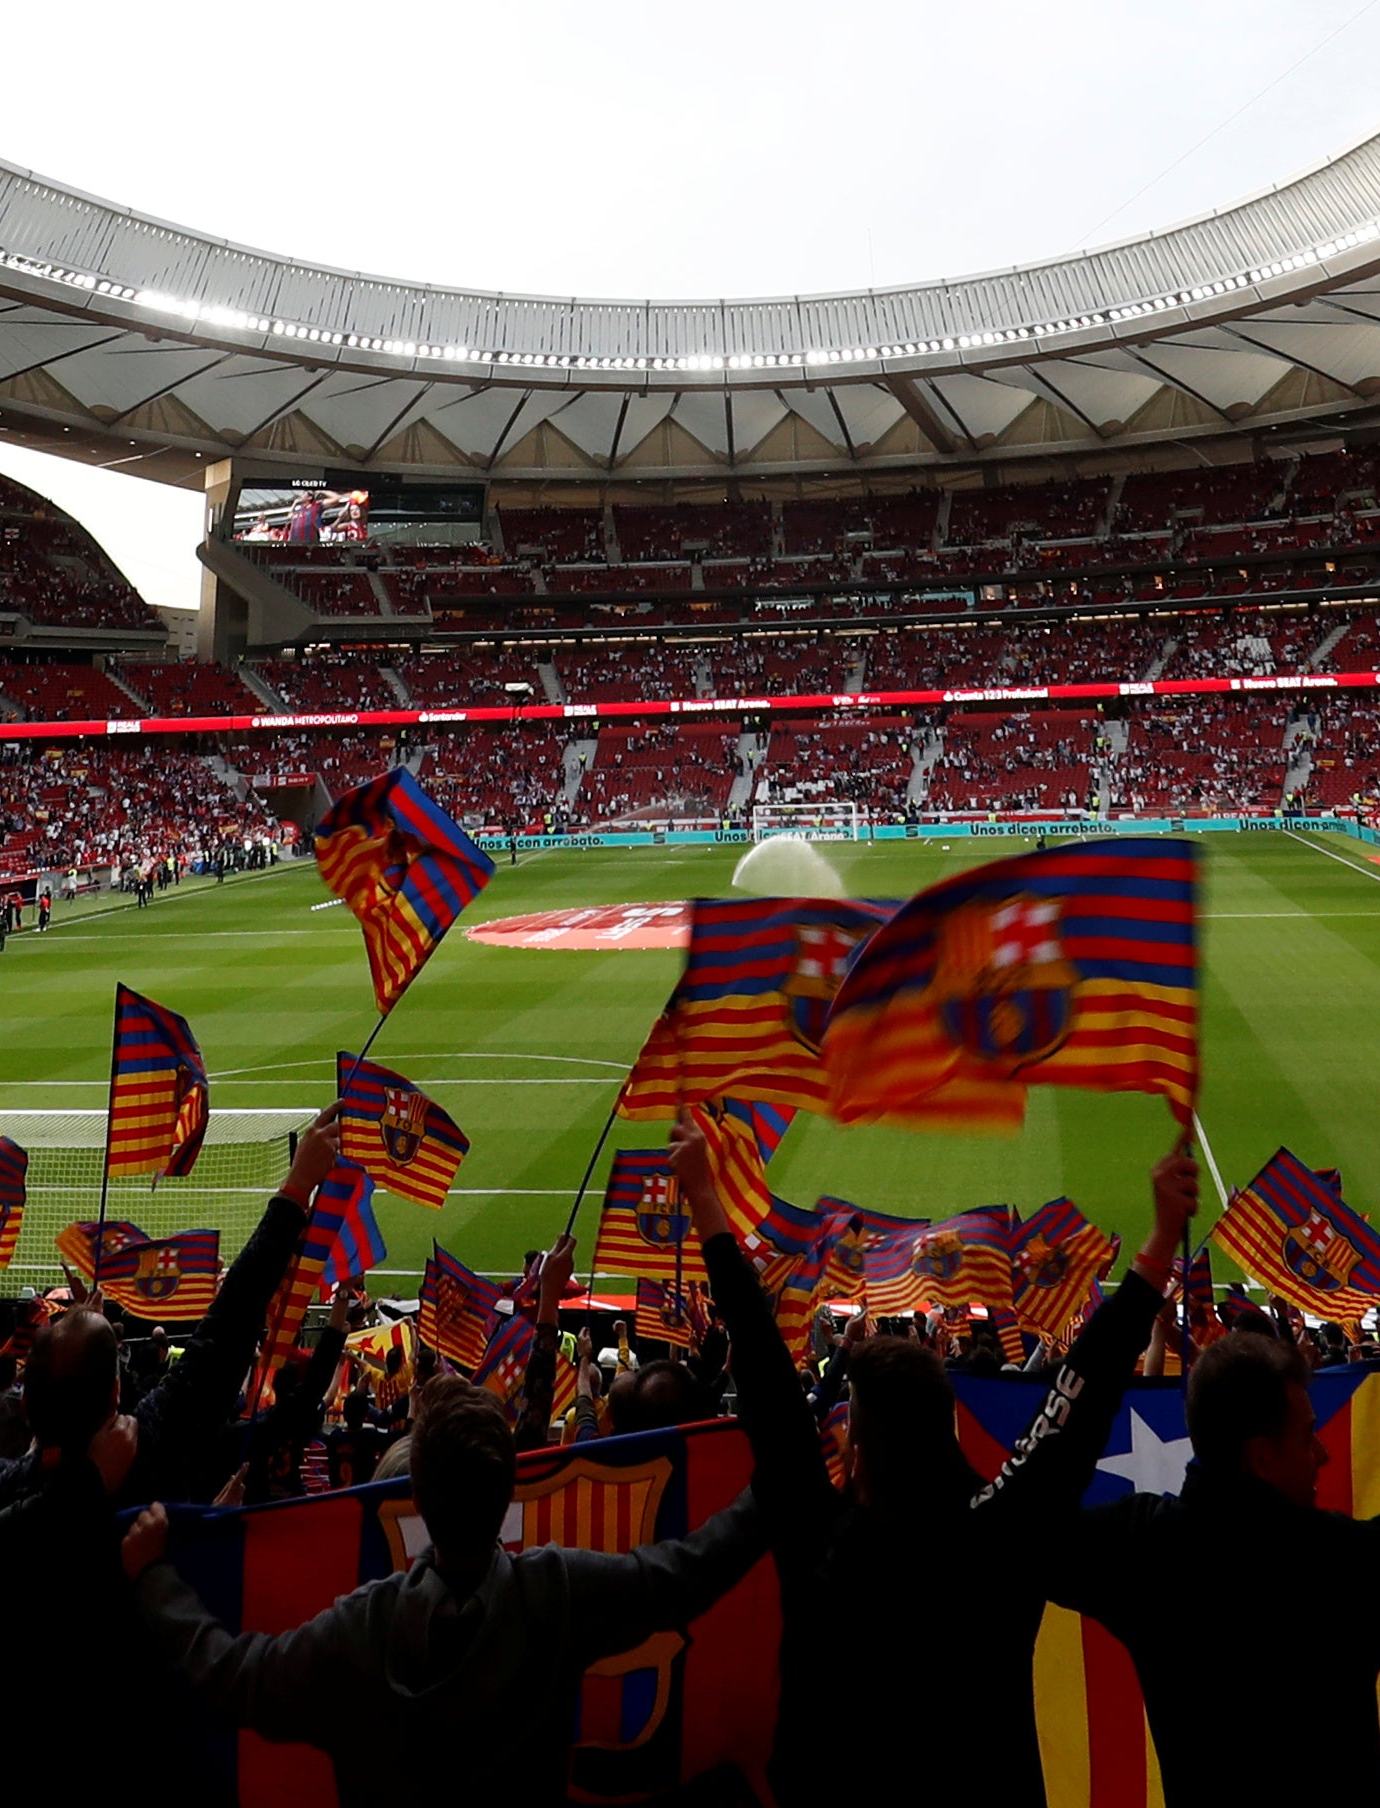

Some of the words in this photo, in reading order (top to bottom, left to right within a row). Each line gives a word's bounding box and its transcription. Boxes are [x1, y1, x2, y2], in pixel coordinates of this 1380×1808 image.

[1277, 677, 1301, 688] SEAT
[714, 699, 737, 710] SEAT
[261, 717, 294, 726] WANDA
[295, 714, 358, 725] METROPOLITANO
[429, 712, 467, 721] Santander
[970, 824, 1005, 836] Unos
[1008, 822, 1048, 835] dicen
[1050, 821, 1117, 834] arrebato.
[1239, 819, 1276, 831] Unos
[1279, 817, 1320, 831] dicen
[715, 831, 747, 842] Unos
